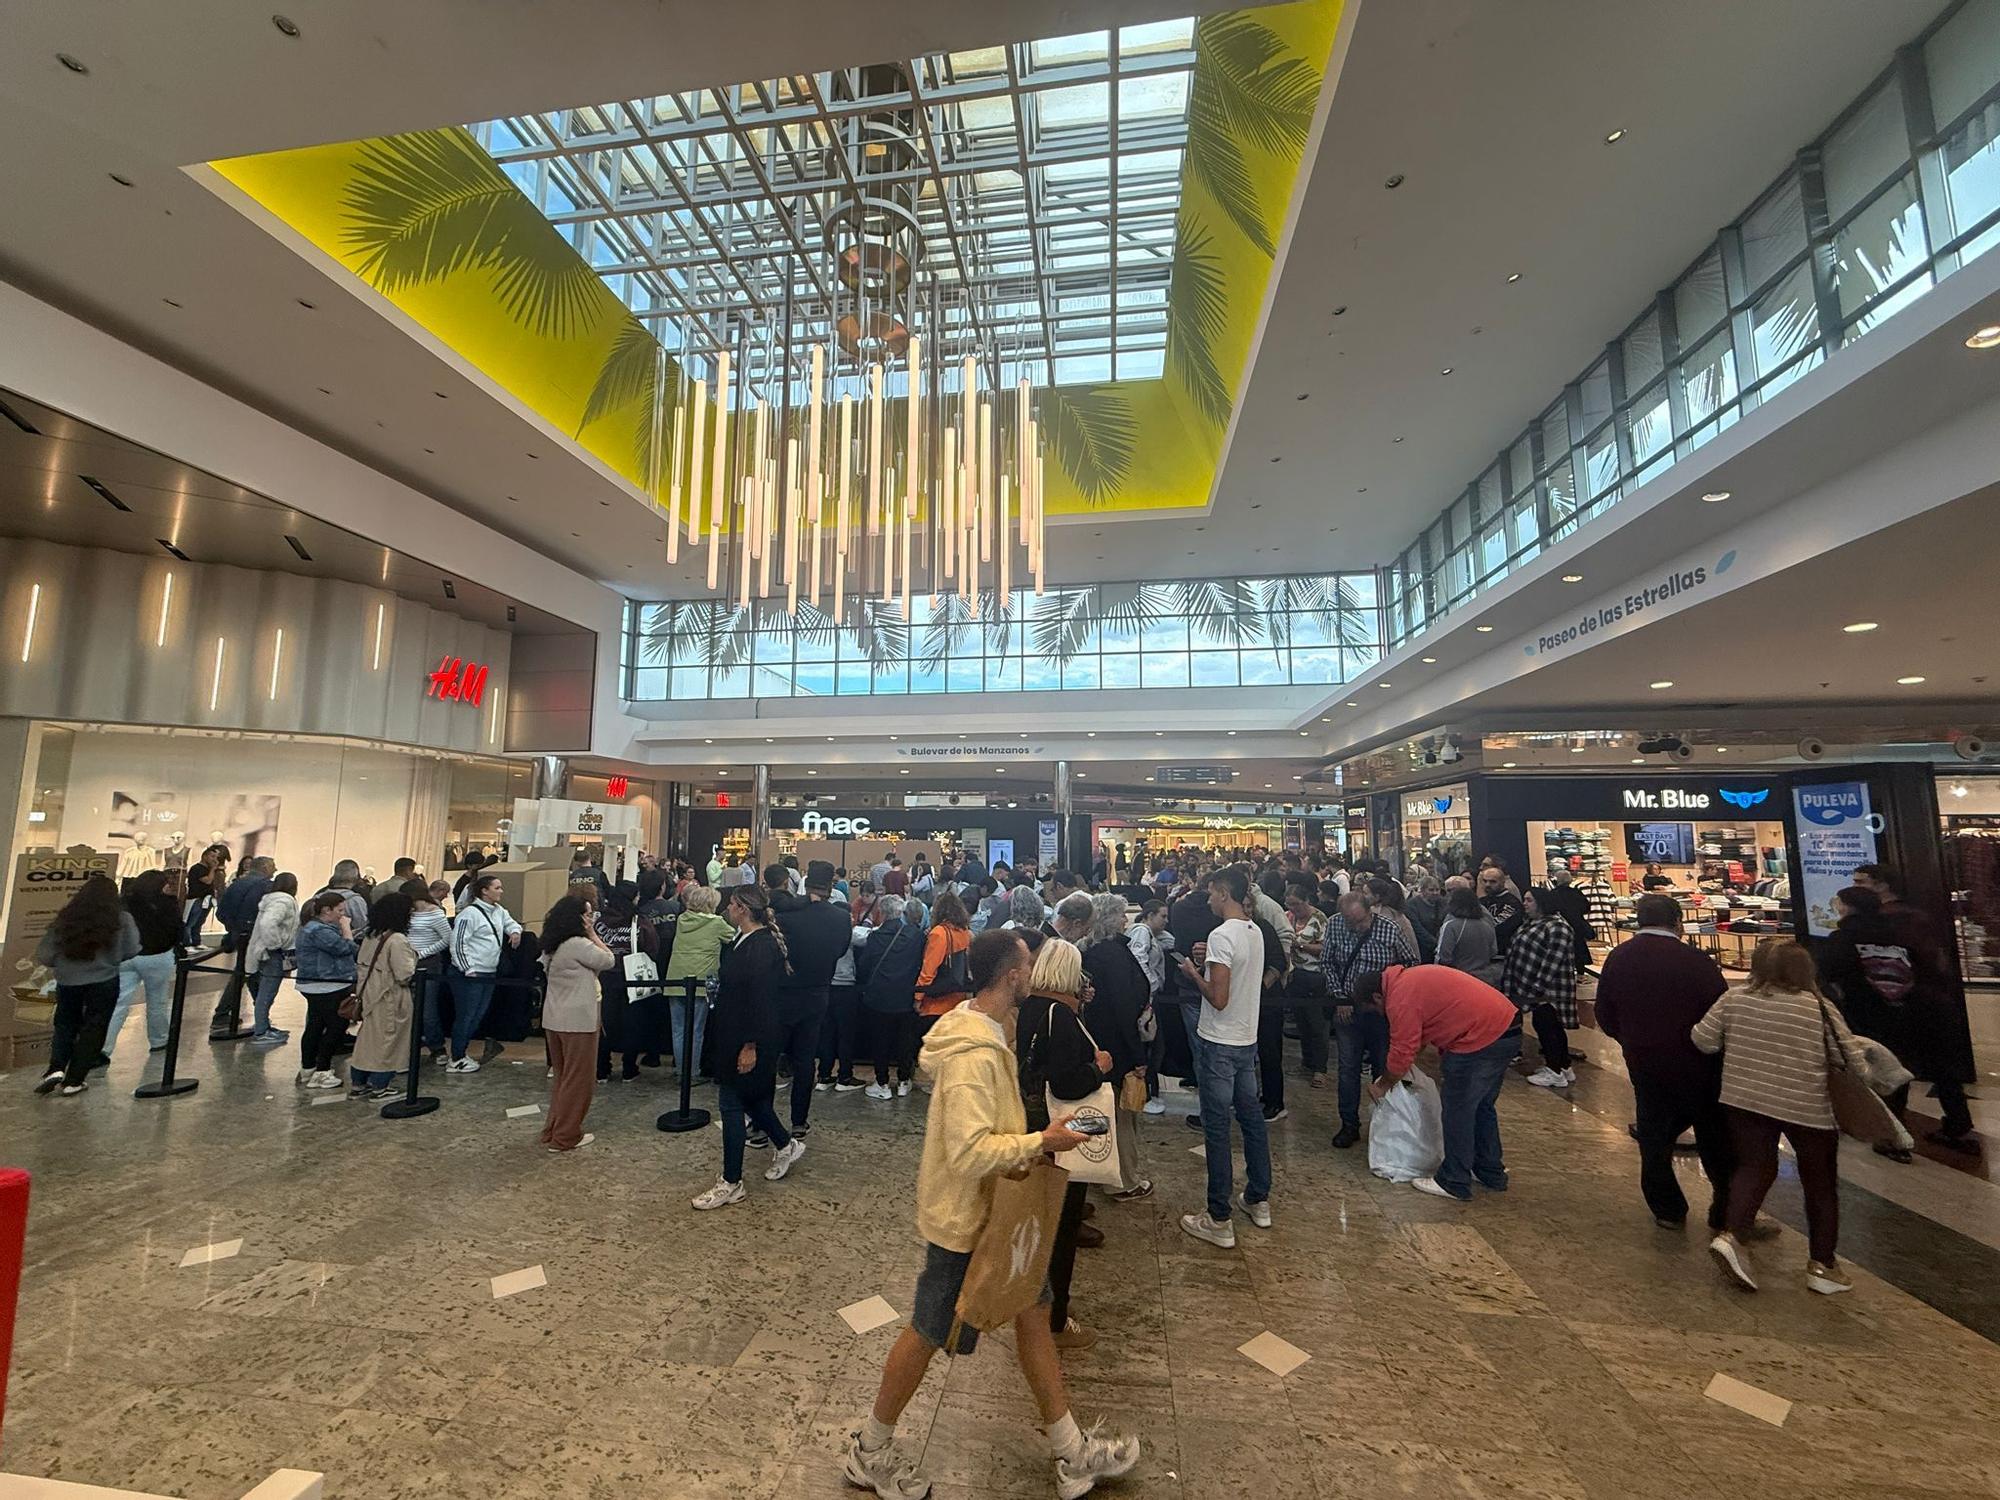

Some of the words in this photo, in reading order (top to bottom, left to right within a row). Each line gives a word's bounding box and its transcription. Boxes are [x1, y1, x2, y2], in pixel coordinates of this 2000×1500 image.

[1538, 626, 1577, 654] Paseo
[1579, 617, 1597, 636] de
[1600, 606, 1623, 628] las
[1624, 566, 1707, 616] Estrellas
[428, 655, 488, 708] H&M
[911, 747, 948, 755] Bulevar
[950, 747, 961, 755] de
[963, 746, 977, 755] los
[979, 746, 1030, 755] Manzanos
[1624, 789, 1659, 809] Mr.
[1661, 789, 1710, 809] Blue
[1802, 793, 1859, 808] PULEVA
[578, 813, 603, 823] KING
[801, 811, 871, 835] fnac
[578, 823, 602, 831] COLIS
[1655, 832, 1673, 840] DAYS
[28, 857, 109, 871] KING
[1823, 858, 1830, 866] el
